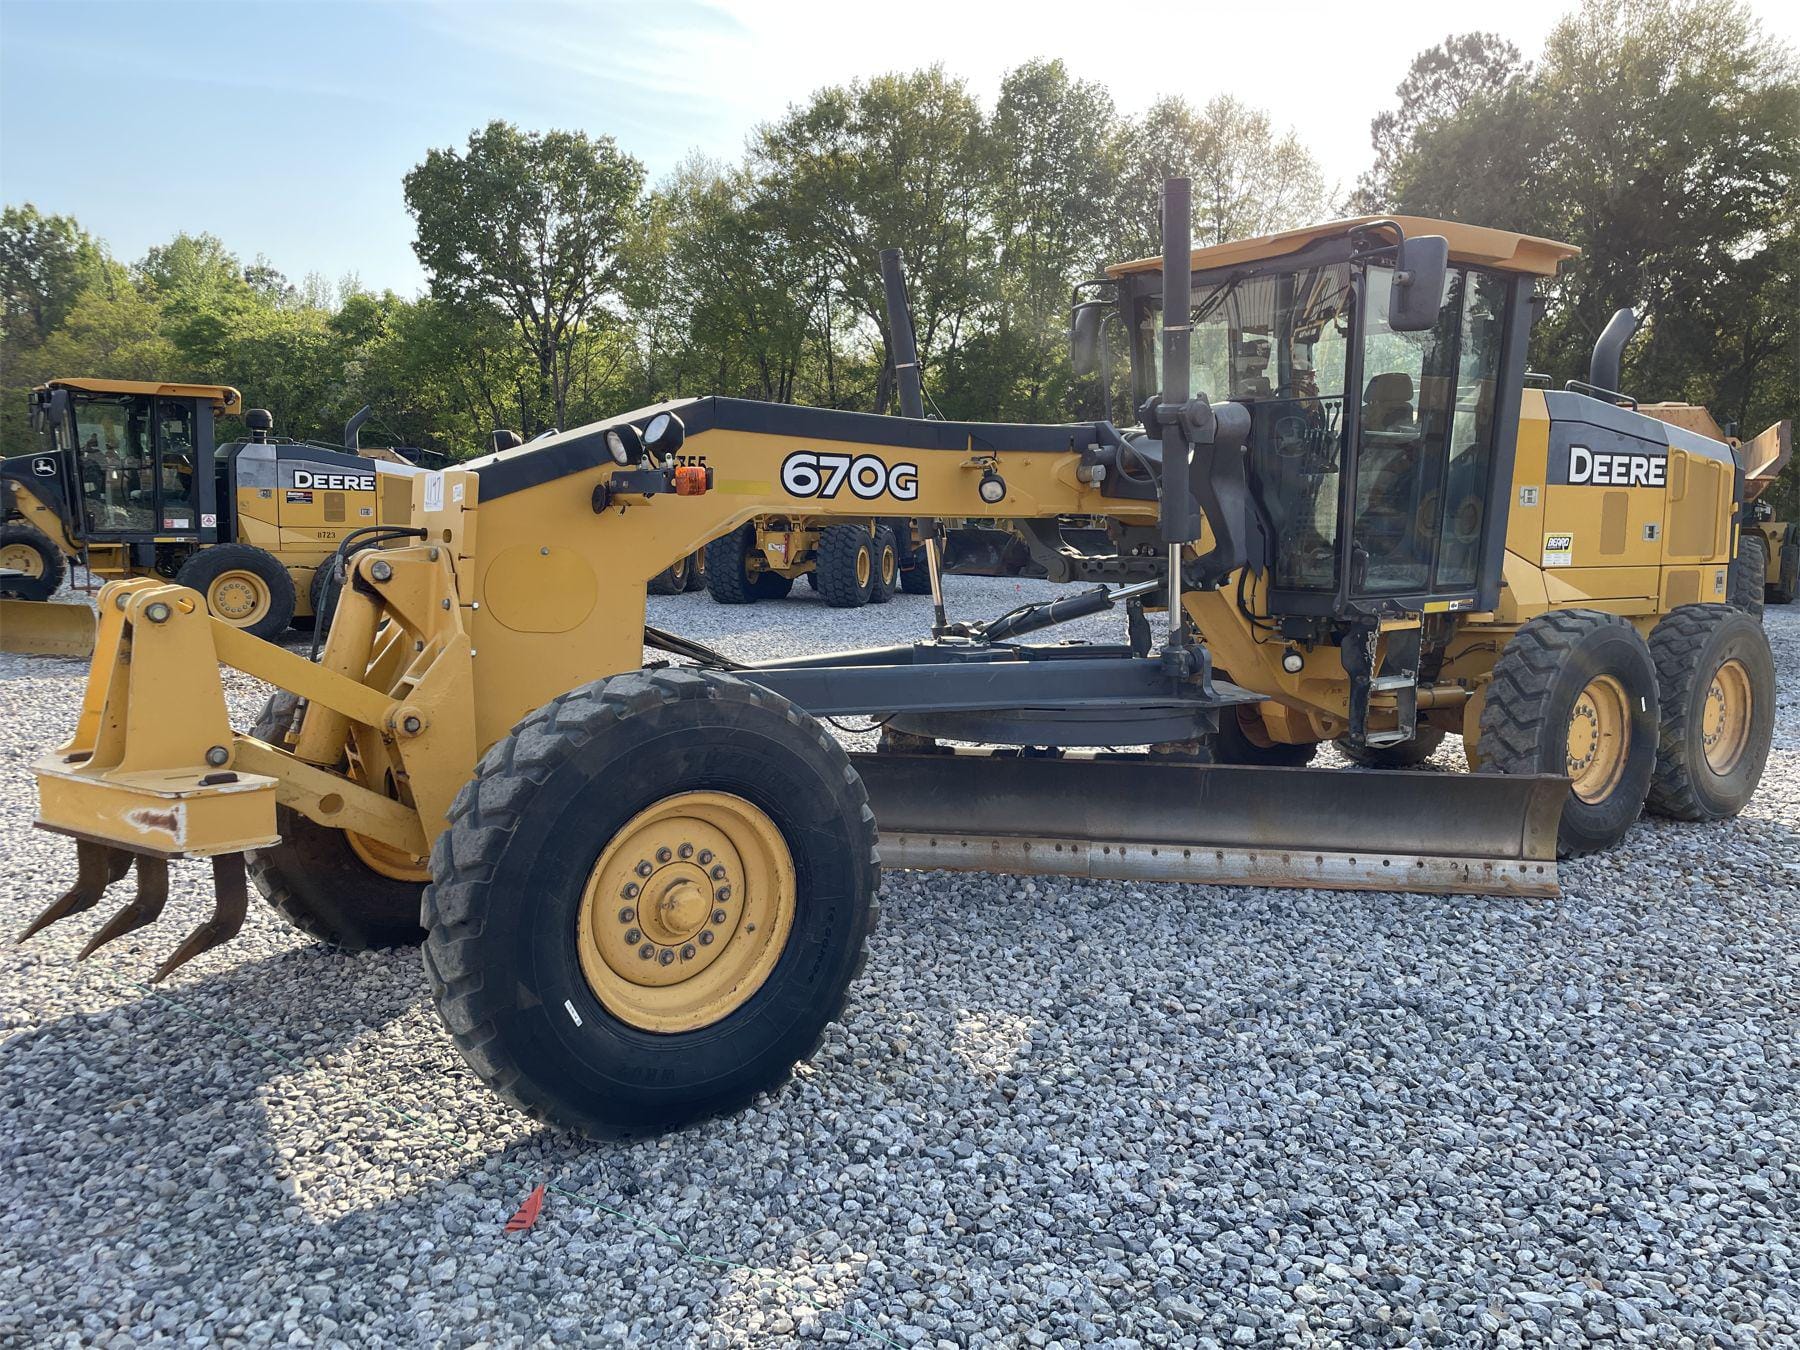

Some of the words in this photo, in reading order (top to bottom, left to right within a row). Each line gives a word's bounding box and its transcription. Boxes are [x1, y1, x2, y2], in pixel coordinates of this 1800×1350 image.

[293, 470, 375, 491] DEERE
[780, 450, 918, 501] 670G
[1568, 446, 1667, 487] DEERE
